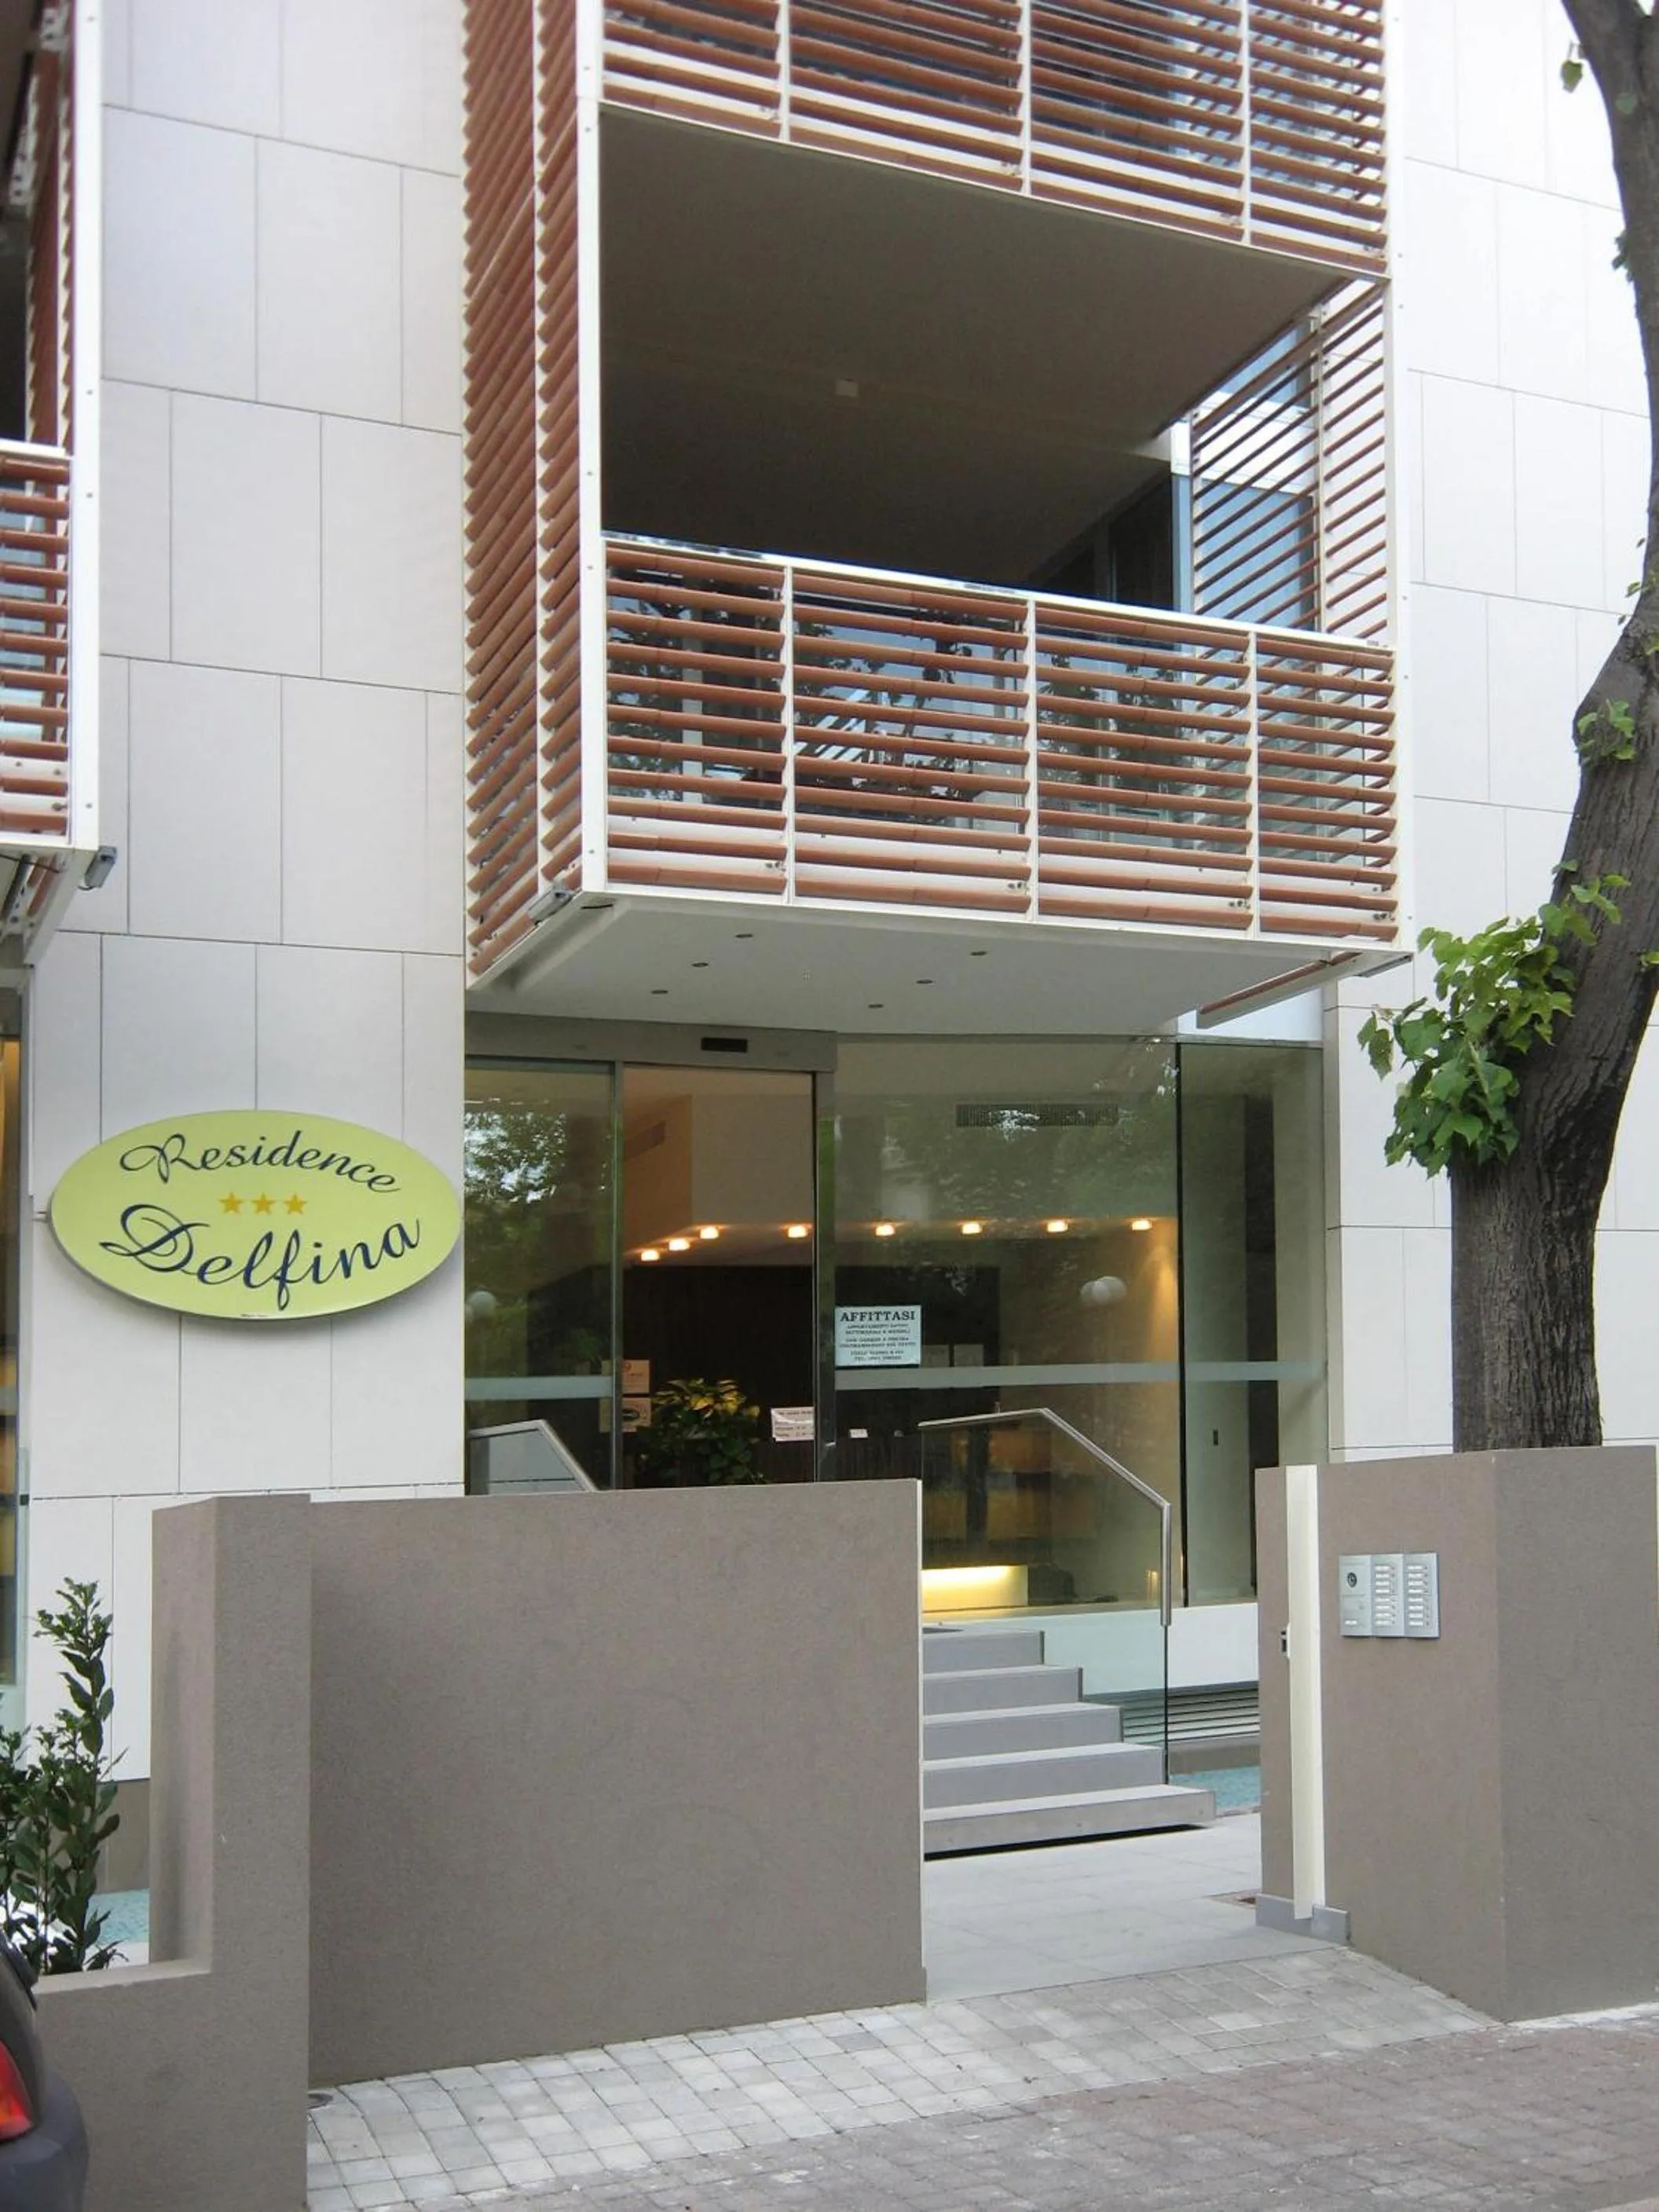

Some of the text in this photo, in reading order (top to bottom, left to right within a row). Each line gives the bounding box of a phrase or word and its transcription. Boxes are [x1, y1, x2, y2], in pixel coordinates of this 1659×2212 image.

[119, 1130, 401, 1192] Residence
[99, 1204, 419, 1309] Delfina
[840, 1311, 916, 1321] AFFITTASI
